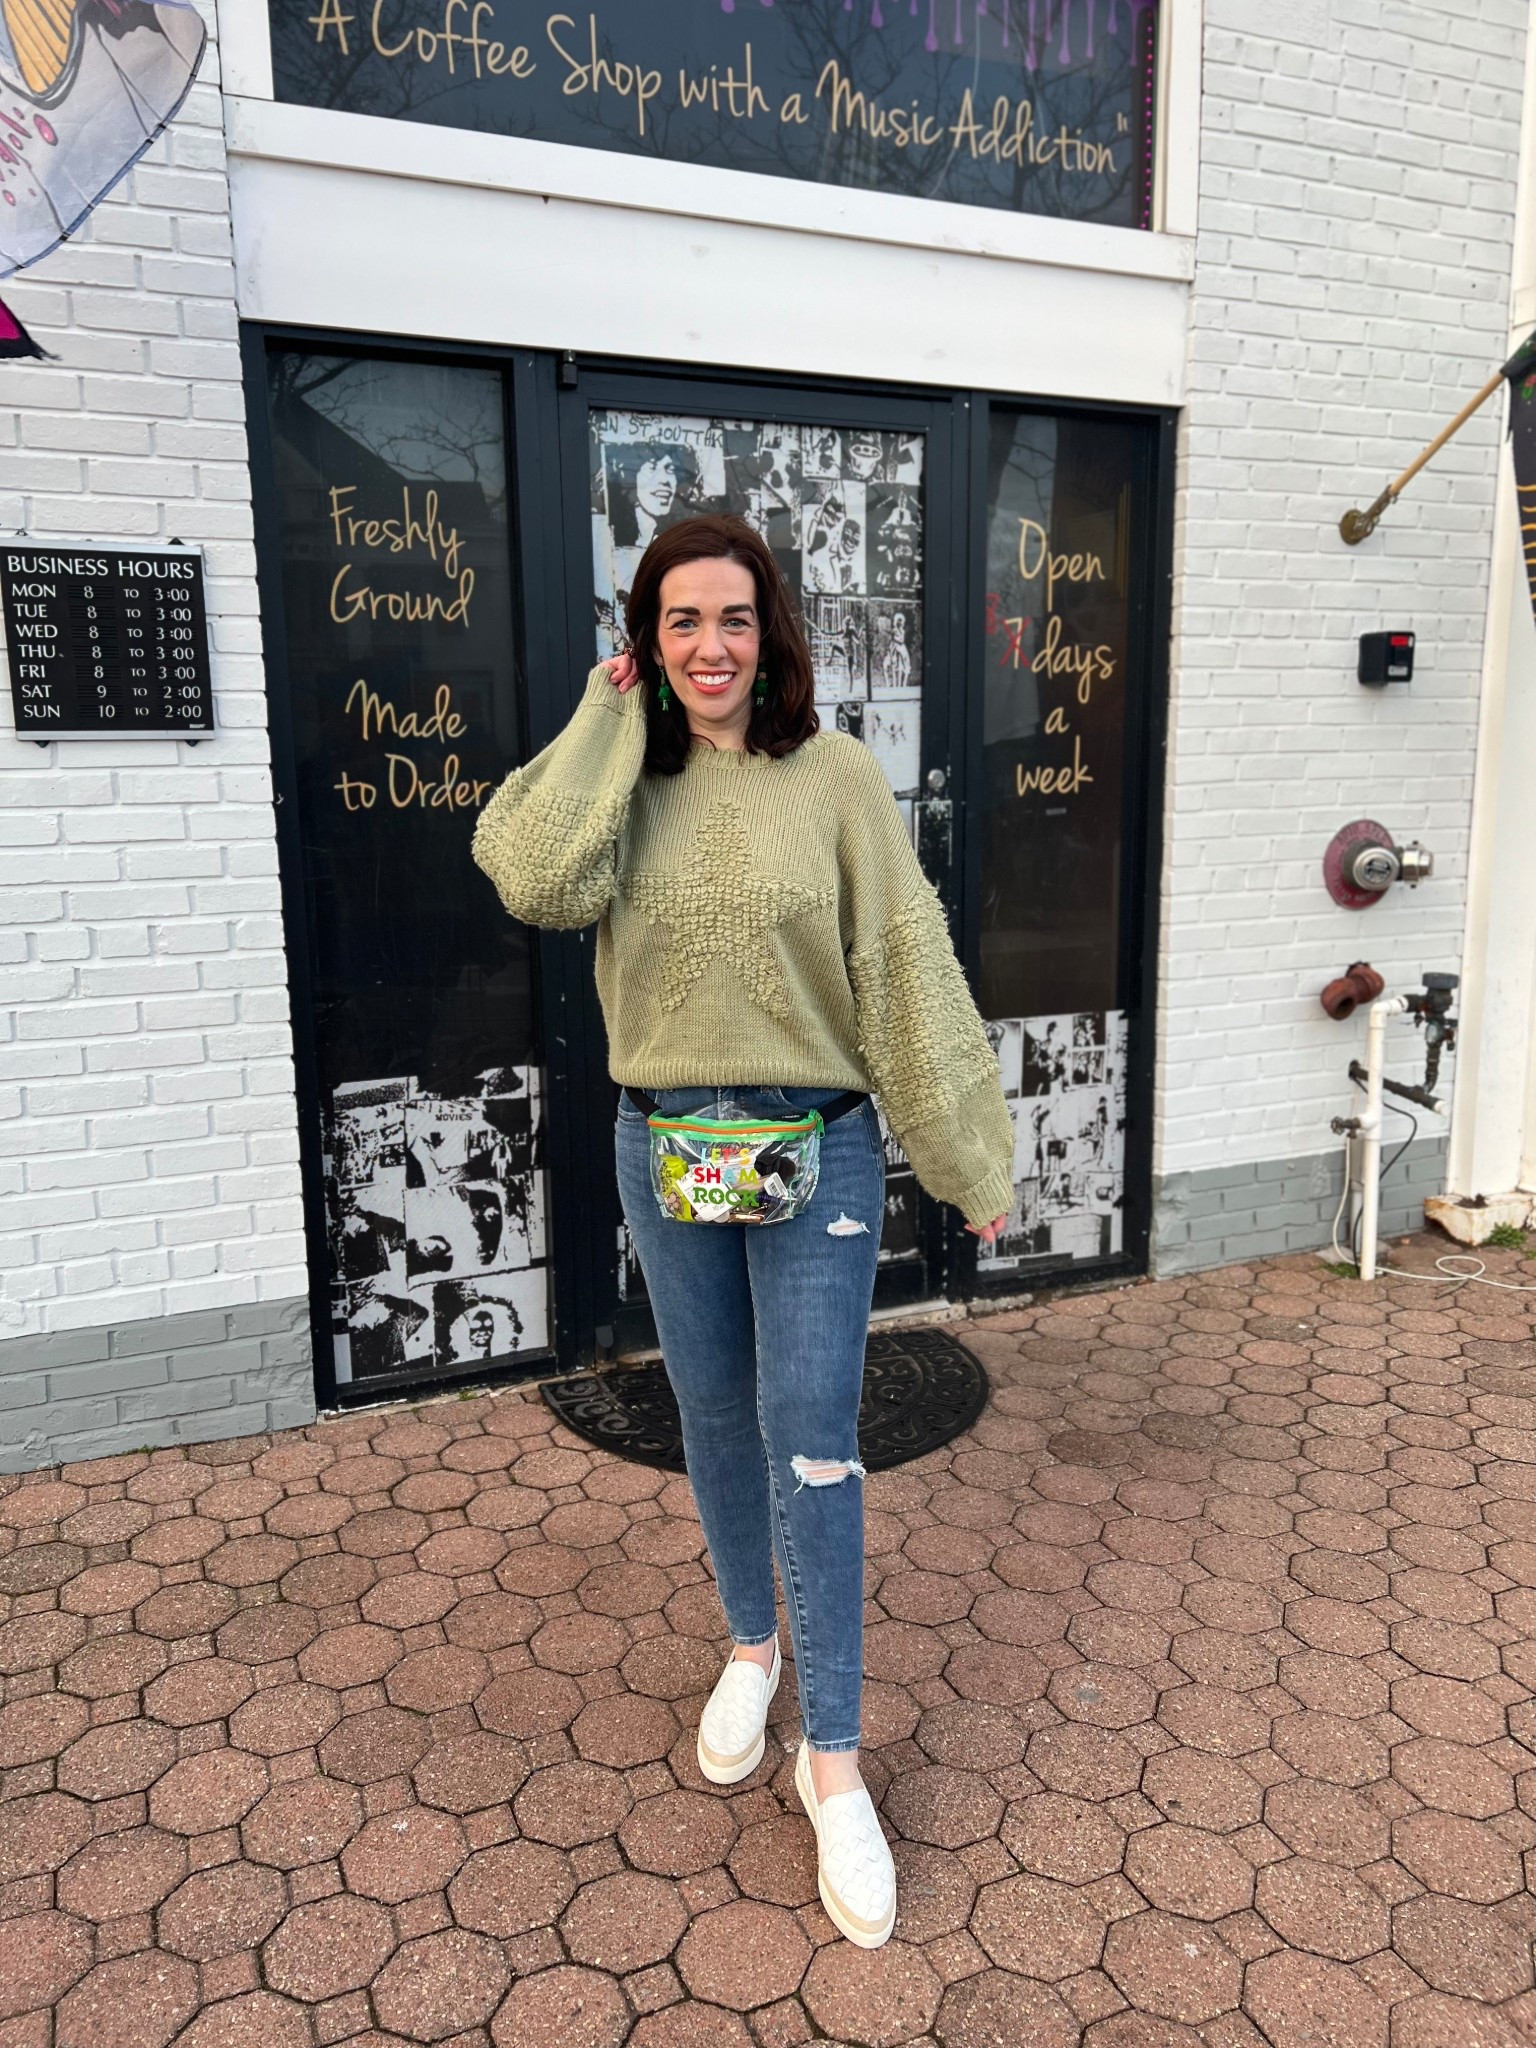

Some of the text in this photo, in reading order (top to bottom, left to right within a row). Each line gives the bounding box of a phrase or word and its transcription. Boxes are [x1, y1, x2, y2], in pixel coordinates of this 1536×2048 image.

[309, 0, 355, 55] A
[371, 0, 537, 79] Coffee
[546, 13, 662, 137] Shop
[680, 42, 770, 118] with
[780, 93, 809, 124] a
[815, 59, 942, 147] Music
[329, 485, 466, 579] Freshly
[8, 556, 194, 578] BUSINESS HOURS
[1018, 517, 1106, 612] Open
[12, 584, 56, 597] MON
[84, 586, 93, 598] 8
[124, 589, 139, 597] TO
[330, 563, 475, 628] Ground
[14, 604, 47, 617] TUE
[88, 606, 96, 618] 8
[127, 609, 140, 617] TO
[16, 624, 57, 638] WED
[89, 626, 98, 638] 8
[127, 629, 142, 637] TO
[93, 646, 101, 658] 8
[1031, 615, 1117, 704] days
[20, 665, 45, 677] FRI
[95, 666, 103, 678] 8
[22, 685, 51, 697] SAT
[97, 686, 106, 697] 9
[134, 688, 147, 696] TO
[24, 705, 60, 717] SUN
[100, 705, 115, 717] 10
[345, 679, 467, 744] Made
[1045, 707, 1070, 734] a
[1016, 735, 1094, 796] week
[333, 753, 491, 813] to Order
[435, 1113, 473, 1121] MOVIES
[700, 1147, 751, 1166] LET'S
[694, 1166, 759, 1185] SHAM
[692, 1186, 761, 1208] ROCK
